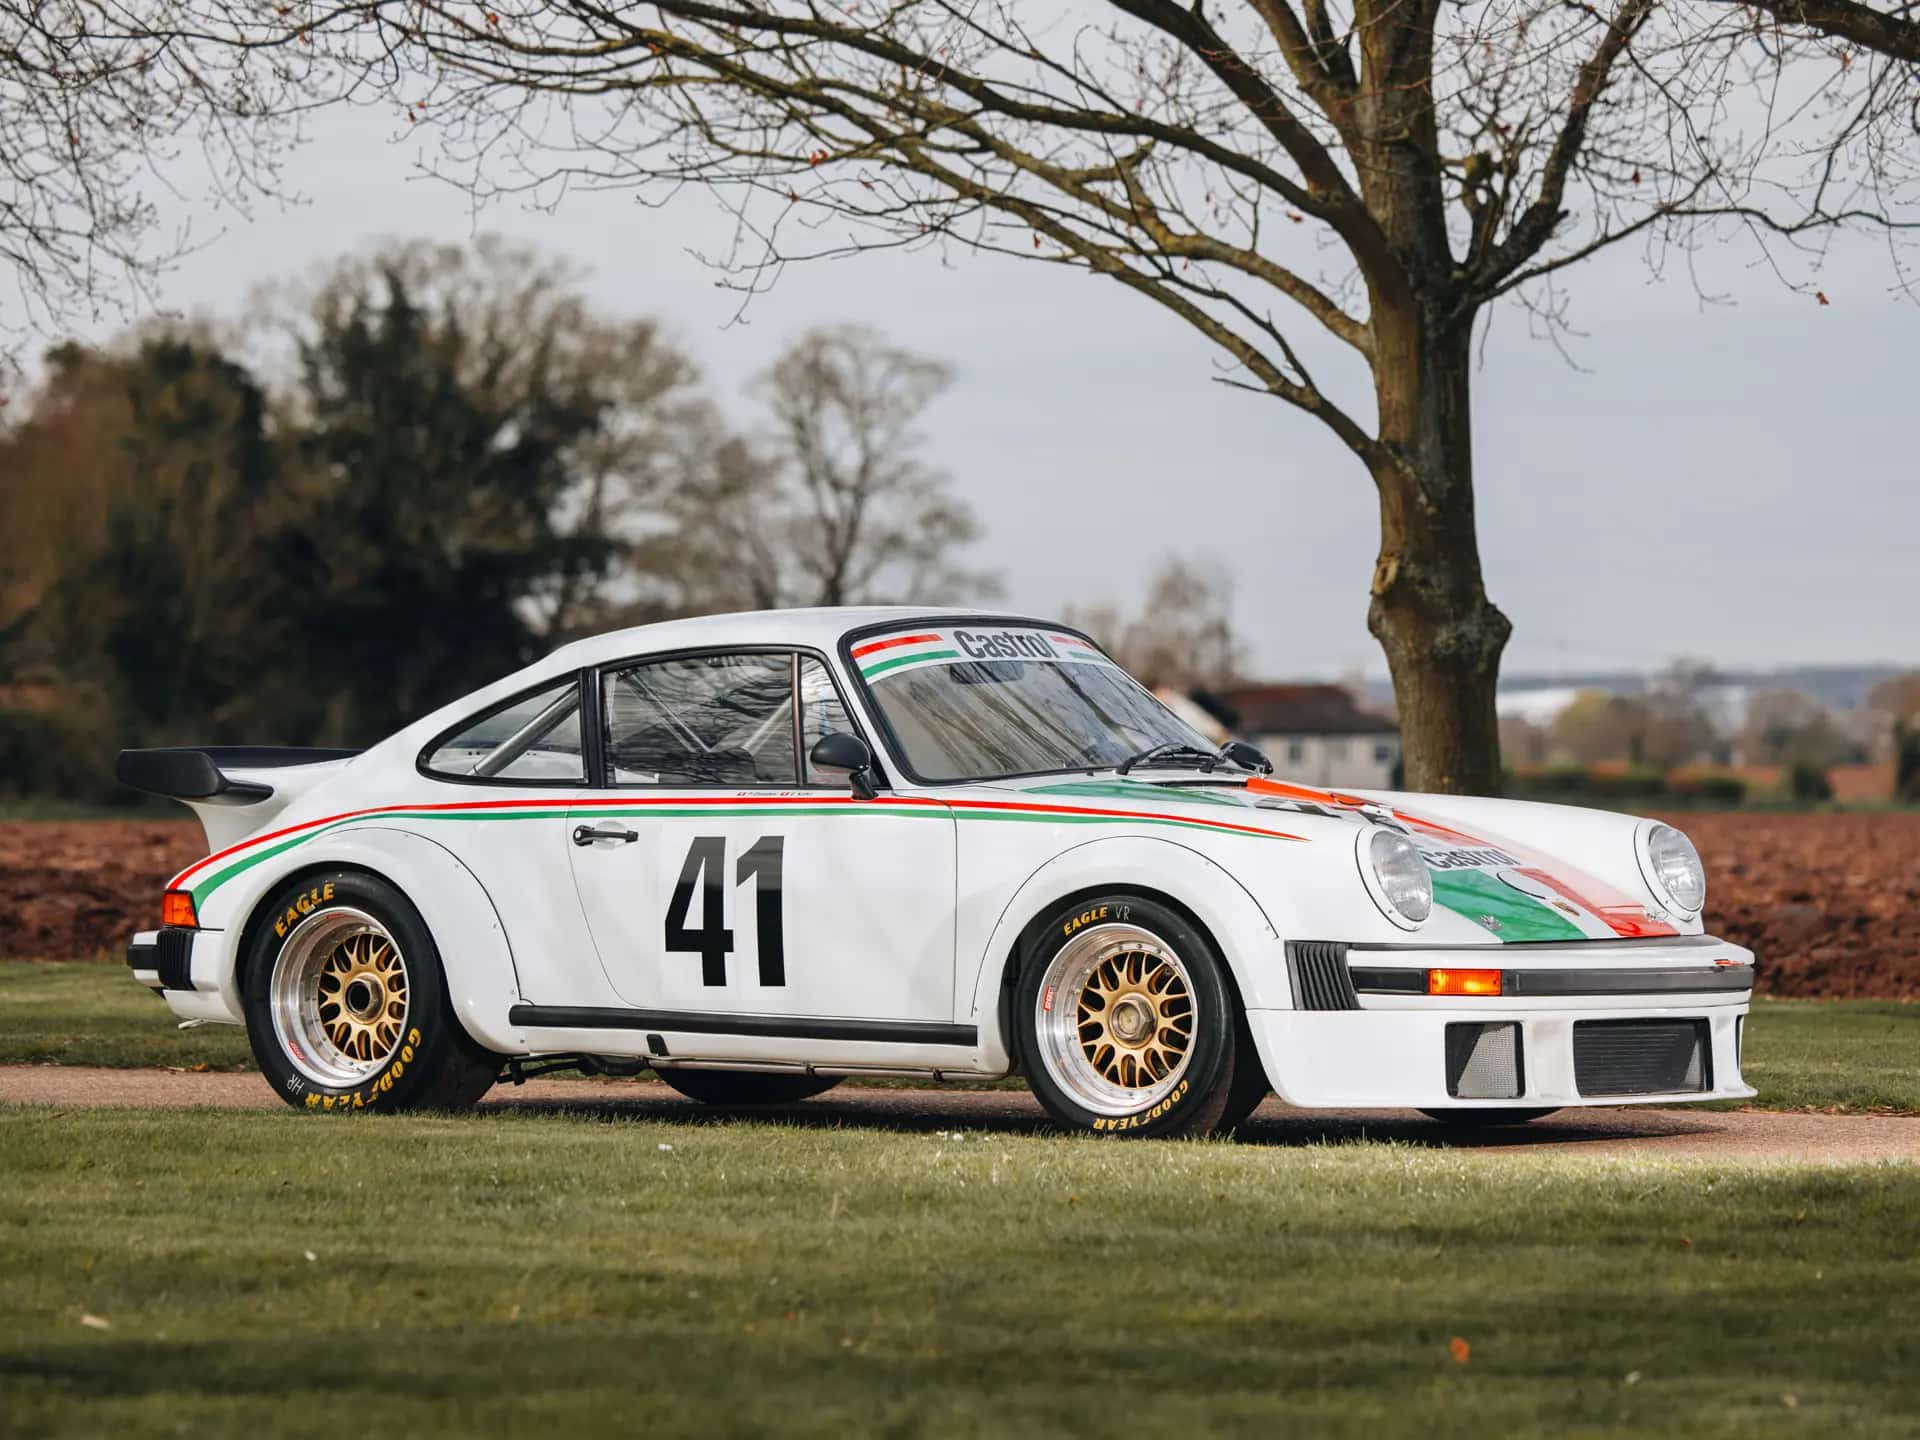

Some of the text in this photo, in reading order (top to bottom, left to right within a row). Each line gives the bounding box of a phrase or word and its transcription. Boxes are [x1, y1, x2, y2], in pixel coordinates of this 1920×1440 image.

[953, 630, 1059, 659] Castrol
[1419, 848, 1521, 869] Castrol
[274, 882, 335, 938] EAGLE
[665, 836, 786, 987] 41
[1063, 905, 1130, 936] EAGLE VR
[286, 1073, 305, 1095] HR
